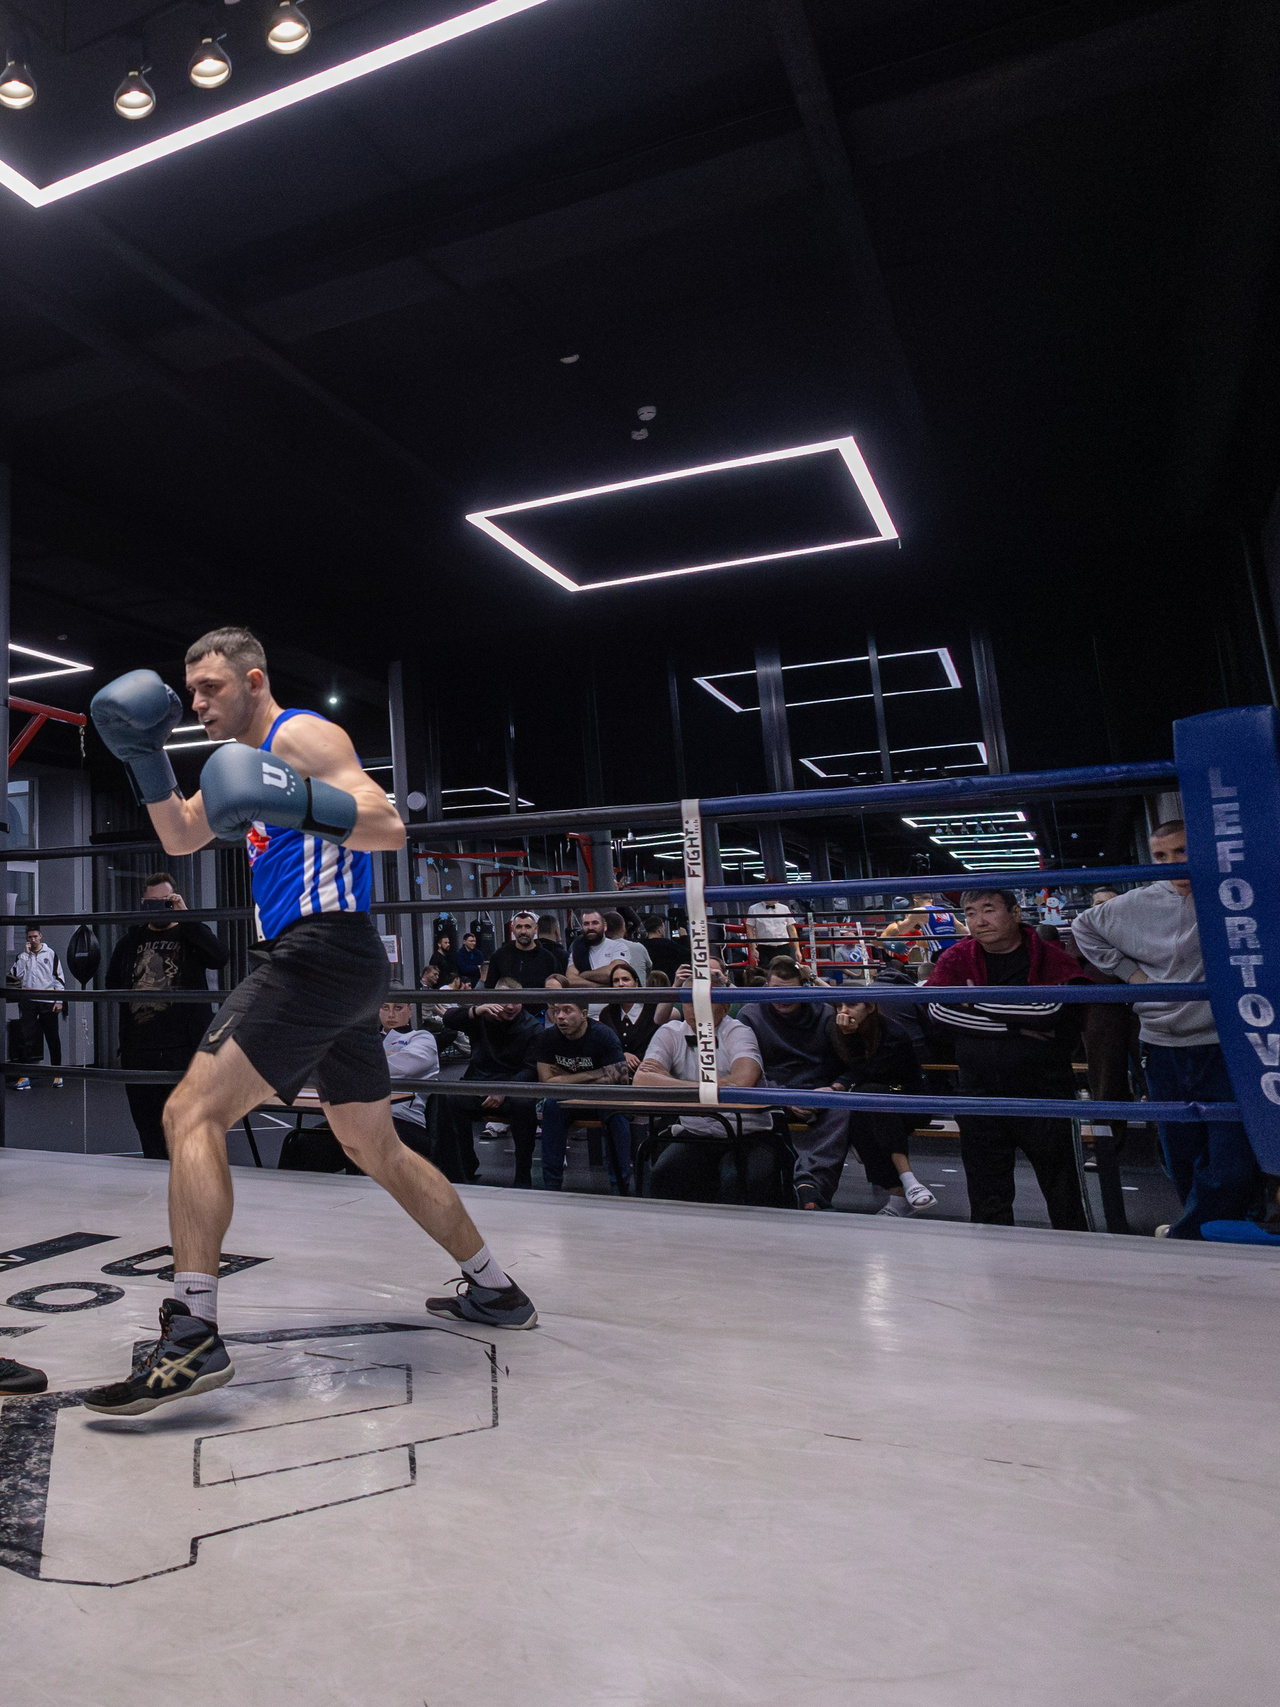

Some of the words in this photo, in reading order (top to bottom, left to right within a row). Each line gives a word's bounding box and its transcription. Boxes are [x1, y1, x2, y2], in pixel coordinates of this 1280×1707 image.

[685, 828, 701, 877] FIGHT
[692, 928, 709, 980] FIGHT
[699, 1030, 716, 1083] FIGHT
